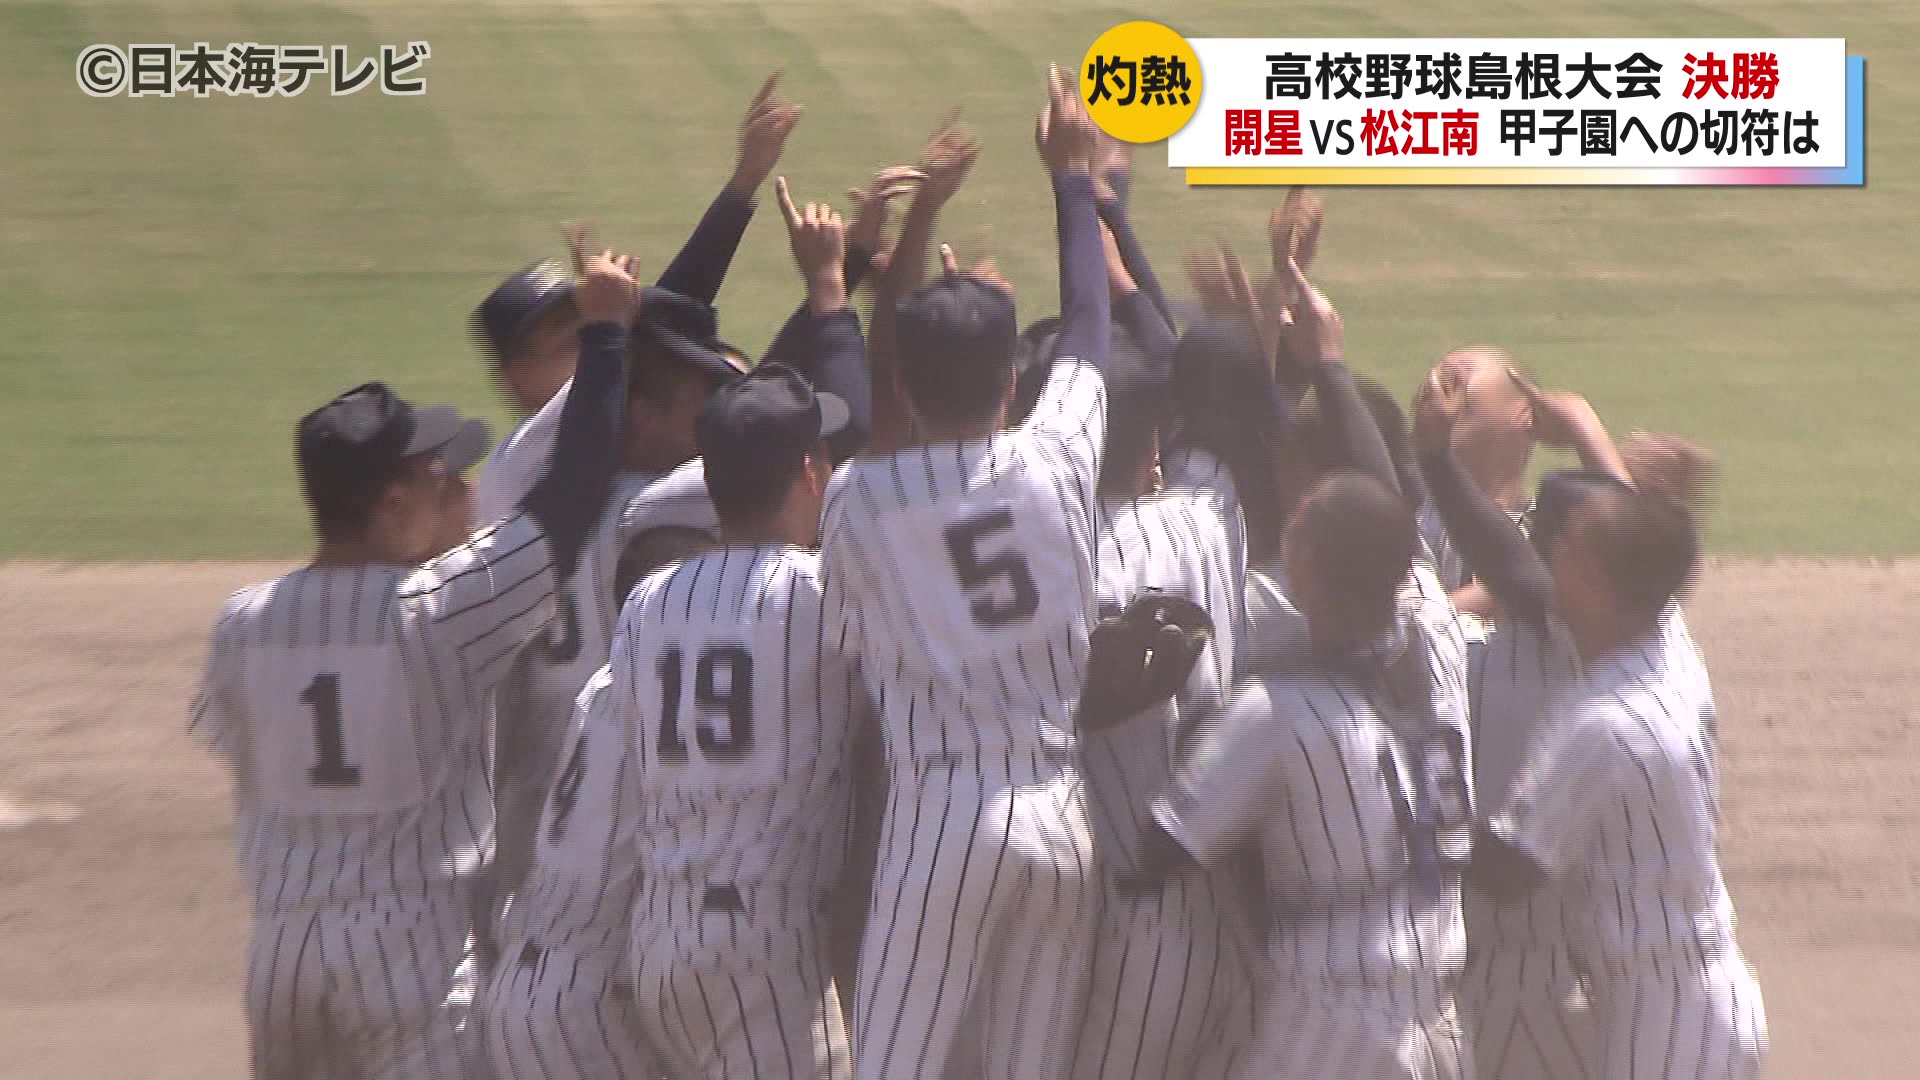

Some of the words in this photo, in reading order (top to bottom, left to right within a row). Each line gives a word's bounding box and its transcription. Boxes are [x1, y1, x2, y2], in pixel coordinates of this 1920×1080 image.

[943, 507, 1040, 626] 5
[300, 673, 363, 787] 1
[655, 646, 755, 764] 19
